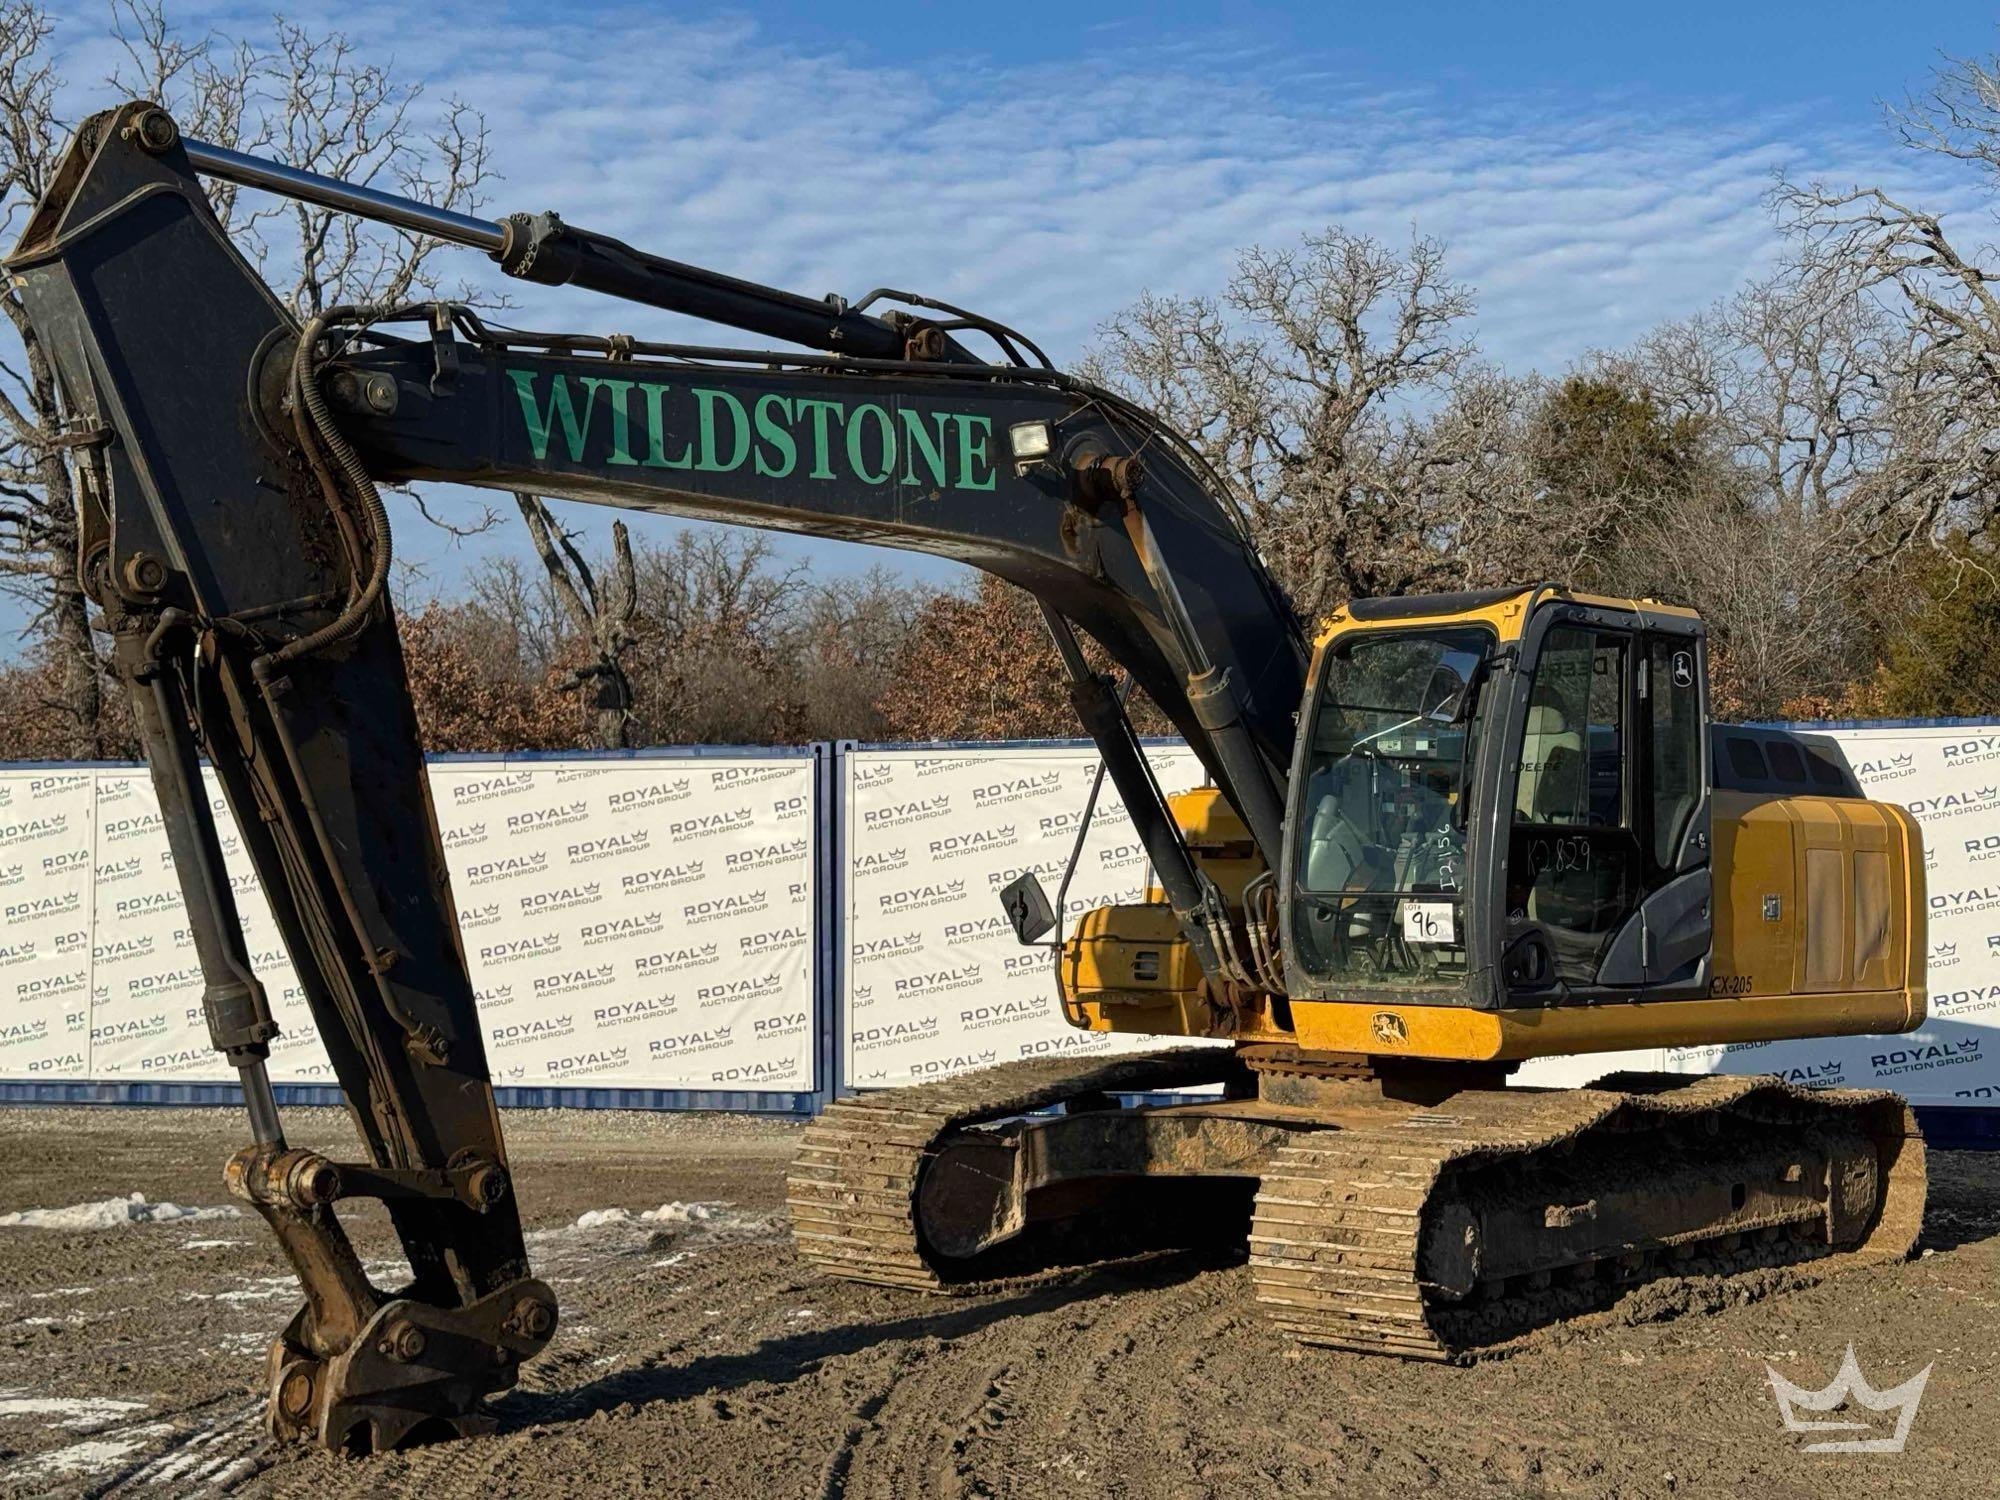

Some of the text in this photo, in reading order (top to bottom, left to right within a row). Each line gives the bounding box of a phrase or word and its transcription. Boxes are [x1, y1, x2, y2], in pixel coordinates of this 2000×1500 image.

[506, 369, 995, 491] WILDSTONE
[714, 769, 796, 792] AUCTION GROUP
[917, 762, 963, 777] AUCTION
[1871, 768, 1916, 783] GROUP
[33, 785, 72, 799] AUCTION
[454, 776, 517, 798] ROYAL
[456, 783, 535, 806] AUCTION GROUP
[857, 777, 893, 790] GROUP
[973, 776, 1042, 801] ROYAL
[100, 792, 131, 804] GROUP
[609, 784, 673, 807] ROYAL
[611, 791, 691, 814] AUCTION GROUP
[975, 784, 1062, 809] AUCTION GROUP
[1909, 792, 1975, 813] OYAL
[508, 806, 571, 828] ROYAL
[865, 800, 932, 824] ROYAL
[867, 808, 951, 832] AUCTION GROUP
[37, 826, 68, 838] GROUP
[108, 828, 147, 841] AUCTION
[510, 813, 589, 836] AUCTION GROUP
[670, 812, 735, 835] ROYAL
[672, 820, 754, 843] AUCTION GROUP
[454, 836, 488, 848] GROUP
[568, 835, 632, 858] ROYAL
[930, 829, 998, 853] ROYAL
[932, 837, 1017, 862] AUCTION GROUP
[570, 842, 650, 865] AUCTION GROUP
[726, 843, 791, 866] ROYAL
[45, 863, 85, 876] AUCTION
[111, 869, 142, 881] GROUP
[467, 856, 529, 878] ROYAL
[470, 864, 547, 886] AUCTION GROUP
[622, 865, 687, 888] ROYAL
[728, 860, 773, 874] AUCTION
[872, 861, 909, 873] GROUP
[624, 873, 706, 896] AUCTION GROUP
[117, 892, 176, 912] ROYAL
[520, 886, 584, 909] ROYAL
[523, 894, 602, 917] AUCTION GROUP
[684, 895, 749, 918] ROYAL
[881, 884, 948, 908] ROYAL
[883, 892, 967, 916] AUCTION GROUP
[1930, 888, 1998, 908] OYAL
[5, 897, 63, 918] ROYAL
[7, 904, 80, 925] AUCTION GROUP
[119, 907, 159, 920] AUCTION
[686, 903, 768, 926] AUCTION GROUP
[467, 916, 501, 929] GROUP
[582, 916, 645, 939] ROYAL
[1412, 911, 1438, 937] 96
[584, 924, 663, 947] AUCTION GROUP
[740, 927, 806, 948] ROYAL
[853, 937, 904, 955] OYAL
[948, 932, 994, 946] AUCTION
[93, 938, 138, 957] OYAL
[124, 949, 154, 960] GROUP
[480, 938, 544, 960] ROYAL
[483, 945, 562, 968] AUCTION GROUP
[742, 943, 787, 957] AUCTION
[888, 944, 924, 958] GROUP
[6, 954, 36, 965] GROUP
[636, 948, 700, 971] ROYAL
[638, 955, 718, 978] AUCTION GROUP
[17, 974, 75, 995] ROYAL
[129, 970, 188, 991] ROYAL
[534, 968, 598, 991] ROYAL
[537, 976, 616, 999] AUCTION GROUP
[698, 978, 763, 1001] ROYAL
[895, 968, 963, 992] ROYAL
[897, 976, 982, 1001] AUCTION GROUP
[19, 990, 59, 1002] AUCTION
[131, 986, 172, 998] AUCTION
[700, 986, 782, 1009] AUCTION GROUP
[480, 998, 514, 1009] GROUP
[595, 999, 659, 1022] ROYAL
[961, 999, 1030, 1024] ROYAL
[1938, 1001, 1996, 1017] AUCTION
[597, 1006, 677, 1029] AUCTION GROUP
[754, 1012, 806, 1032] ROYA
[963, 1008, 1050, 1032] AUCTION GROUP
[17, 1031, 48, 1043] GROUP
[90, 1019, 150, 1040] ROYAL
[92, 1026, 167, 1047] AUCTION GROUP
[493, 1019, 557, 1042] ROYAL
[495, 1026, 575, 1049] AUCTION GROUP
[757, 1026, 802, 1040] AUCTION
[853, 1021, 920, 1045] ROYAL
[285, 1038, 316, 1050] GROUP
[650, 1031, 714, 1054] ROYAL
[652, 1038, 732, 1061] AUCTION GROUP
[855, 1029, 939, 1053] AUCTION GROUP
[1021, 1035, 1090, 1056] ROYAL
[1073, 1043, 1110, 1054] GROUP
[1669, 1047, 1725, 1063] AUCTION
[1727, 1041, 1772, 1053] GROUP
[142, 1050, 202, 1069] ROYAL
[548, 1050, 611, 1073] ROYAL
[595, 1058, 629, 1071] GROUP
[911, 1055, 978, 1076] ROYAL
[1871, 1043, 1957, 1067] ROYAL
[1875, 1053, 1982, 1077] AUCTION GROUP
[712, 1062, 778, 1081] ROYAL
[762, 1070, 797, 1082] GROUP
